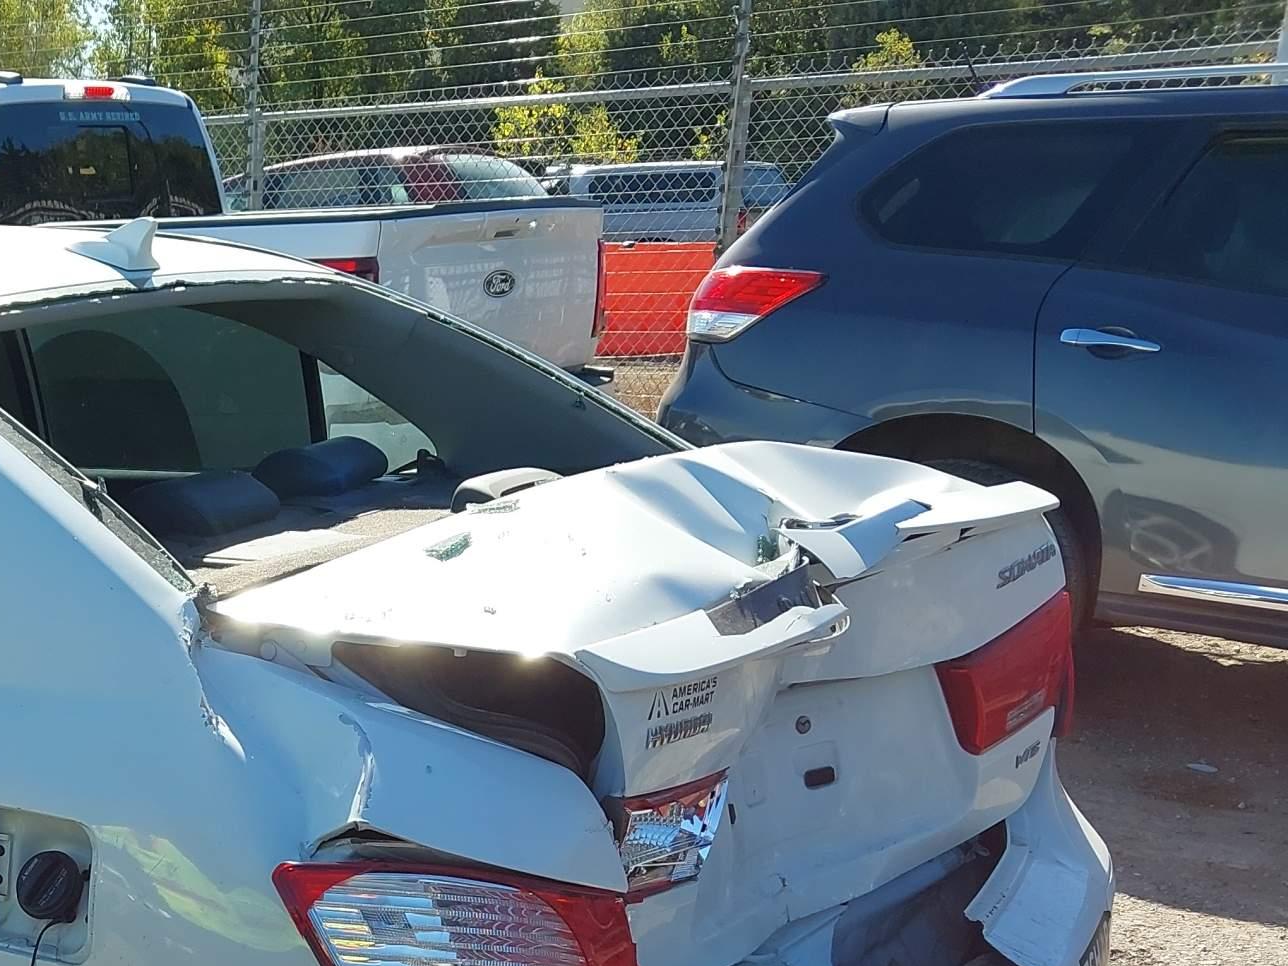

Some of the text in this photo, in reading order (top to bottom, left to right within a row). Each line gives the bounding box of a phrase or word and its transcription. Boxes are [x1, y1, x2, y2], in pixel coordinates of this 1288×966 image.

[79, 111, 103, 121] ARMY
[671, 676, 718, 700] AMERICA'S
[671, 690, 716, 715] CAR-MART
